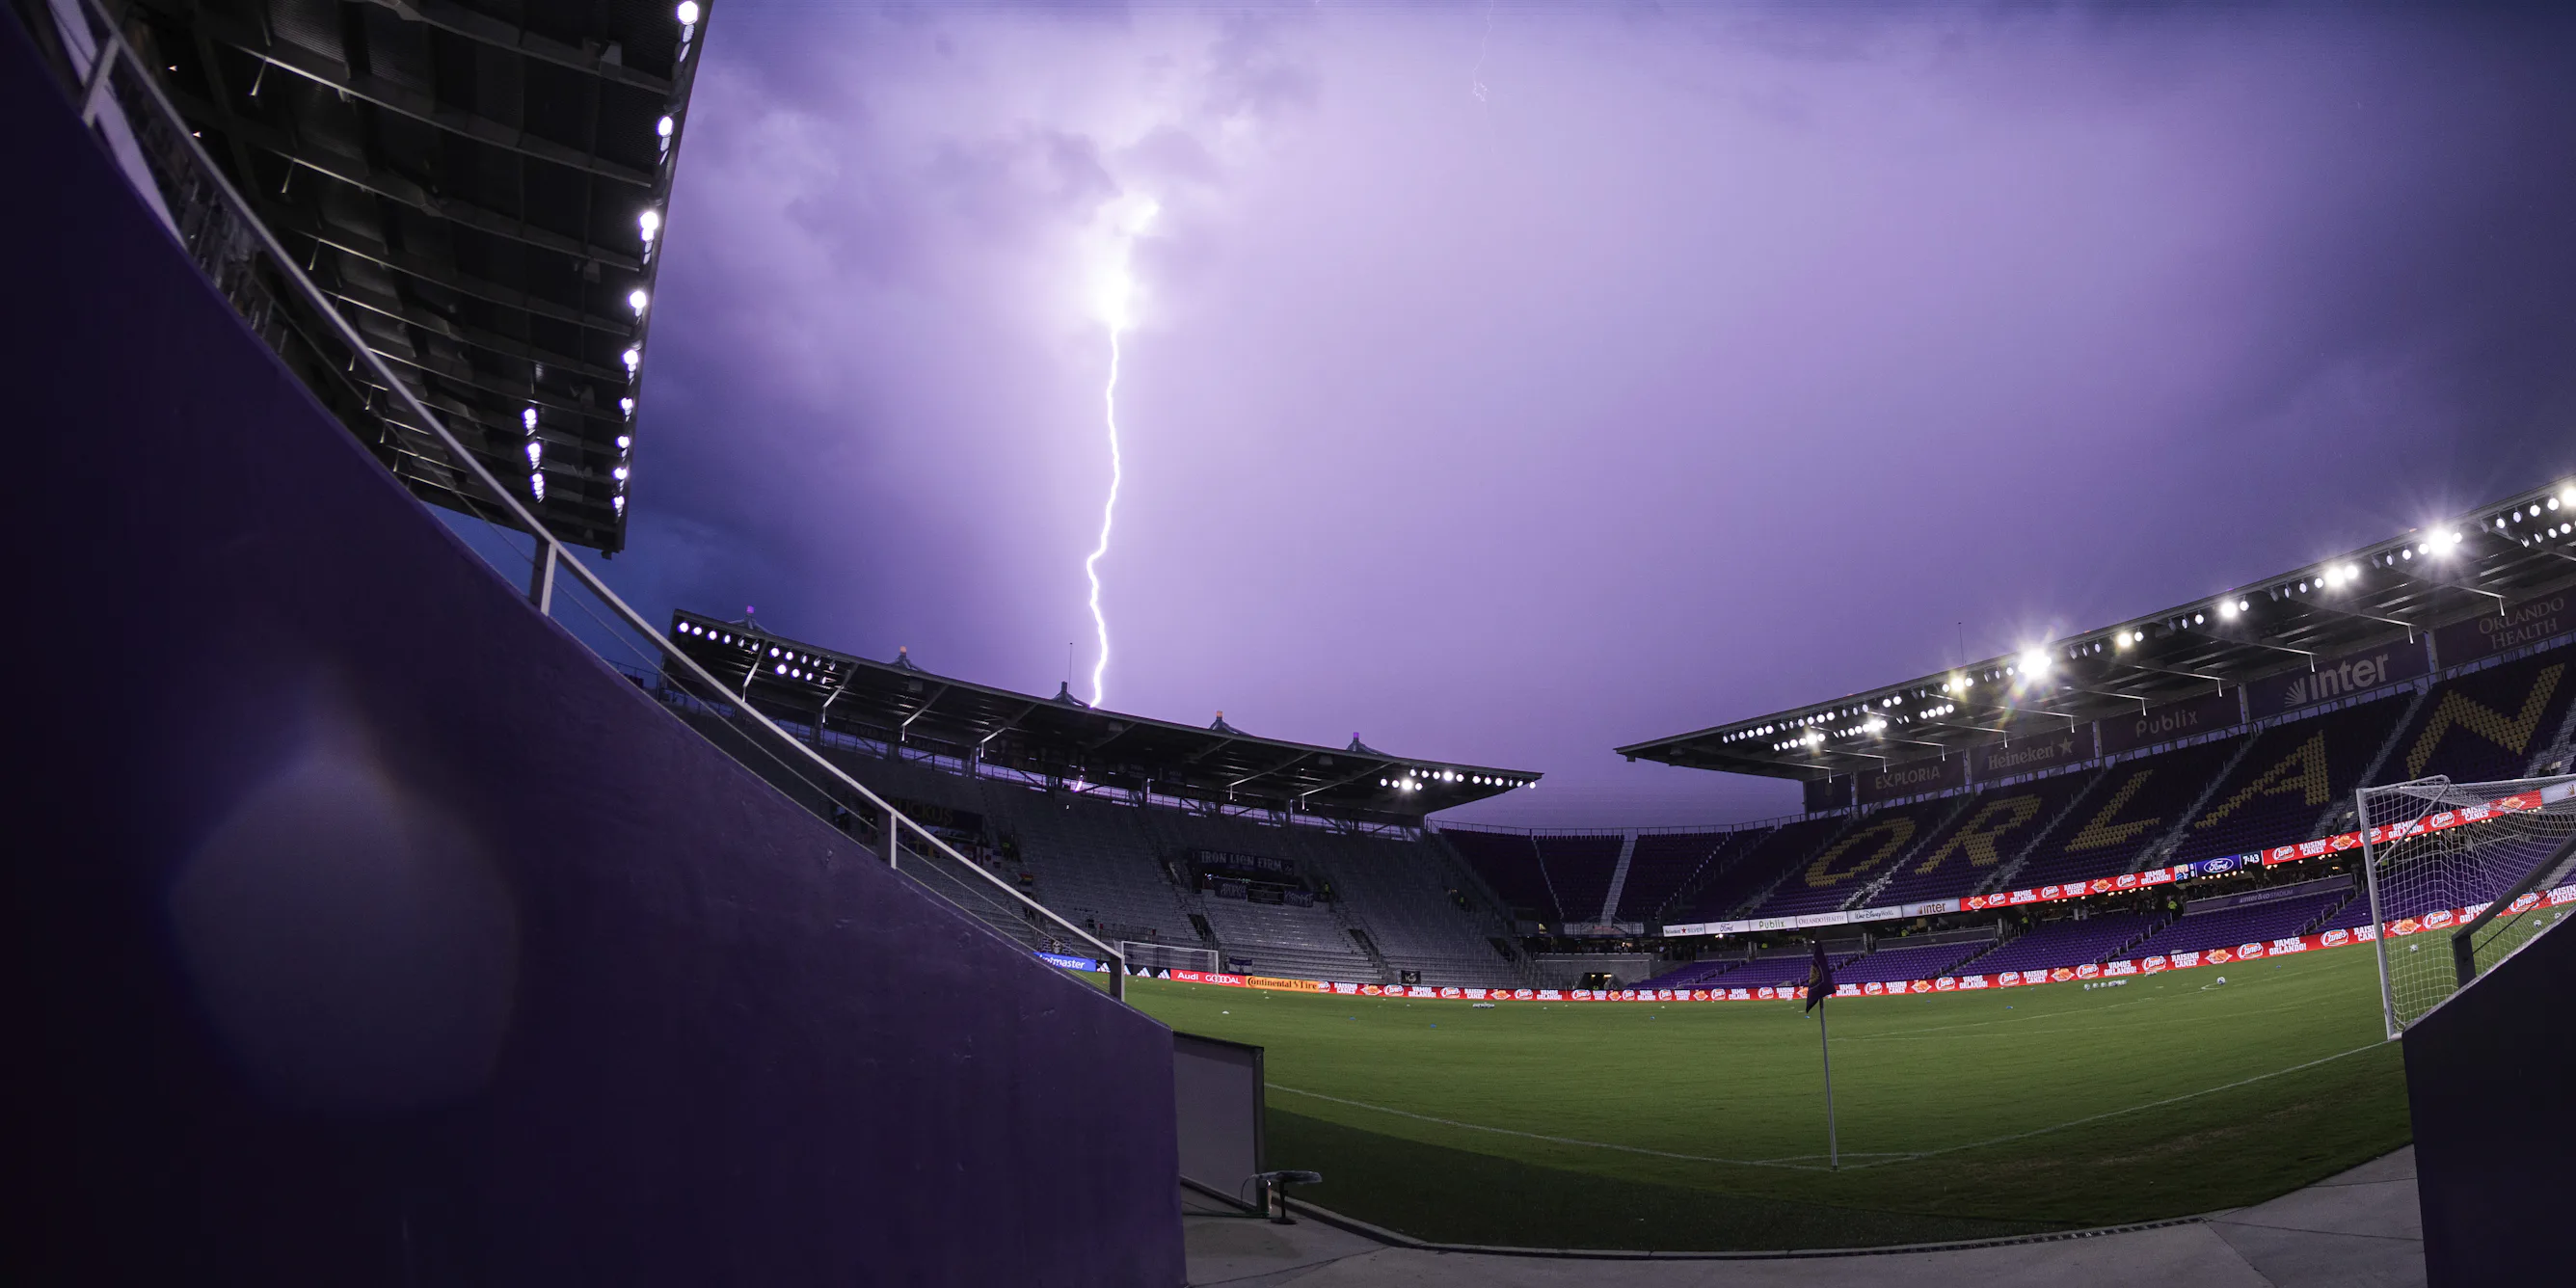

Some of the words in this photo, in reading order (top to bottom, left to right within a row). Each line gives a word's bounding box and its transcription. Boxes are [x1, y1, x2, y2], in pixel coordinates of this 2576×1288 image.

[2479, 598, 2564, 634] ORLANDO
[2491, 617, 2559, 650] HEALTH
[2135, 709, 2198, 738] Publix
[1988, 744, 2055, 770] Heineken
[1875, 765, 1941, 790] EXPLORIA
[2299, 839, 2326, 850] RAISING
[2272, 845, 2294, 860] Cane's
[2209, 859, 2228, 872] Ford
[2242, 853, 2260, 866] 7:43
[2140, 874, 2171, 885] ORLANDO!
[2144, 869, 2165, 878] VAMOS
[2063, 882, 2086, 891] RAISING
[2116, 874, 2136, 887] Cane's
[2009, 895, 2037, 903] ORLANDO!
[2013, 889, 2032, 899] VAMOS
[2270, 889, 2294, 899] STADIUM
[2509, 893, 2538, 911] Cane's
[1758, 919, 1785, 929] Publix
[1799, 917, 1824, 926] ORLANDO
[1823, 915, 1844, 924] HEALTH
[2423, 910, 2453, 928] Cane's
[1720, 924, 1734, 932] Ford
[2353, 923, 2385, 935] RAISIG
[2273, 937, 2300, 947] VAMOS
[2321, 929, 2348, 946] Cane's
[2237, 943, 2264, 959] Cane's
[2268, 943, 2306, 955] ORLANDO!
[2142, 955, 2166, 971] Cane's
[2171, 952, 2199, 962] RAISING
[2107, 960, 2132, 970] VAMOS
[1177, 972, 1199, 980] Audi
[2024, 969, 2048, 979] RAISING
[2076, 964, 2099, 979] Cane's
[2104, 966, 2137, 977] ORLANDO!
[1248, 976, 1291, 989] Continental
[1300, 979, 1317, 990] Tire
[1935, 977, 1955, 990] Cane's
[1963, 975, 1983, 983] VAMOS
[1998, 971, 2020, 985] Cane's
[1959, 980, 1988, 989] ORLANDO!
